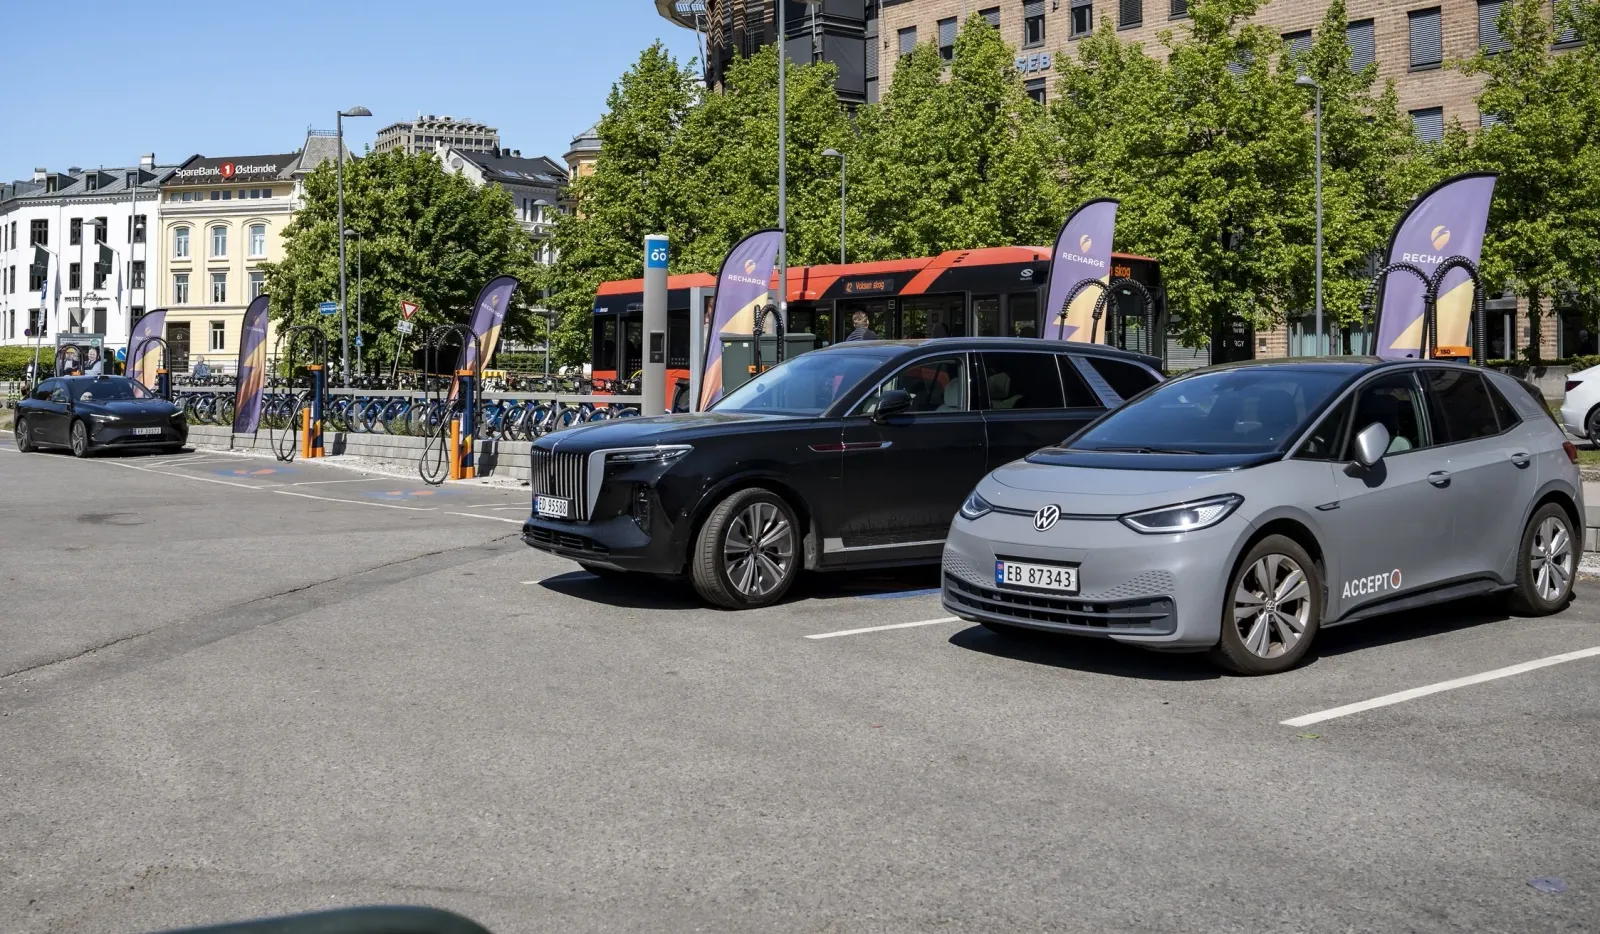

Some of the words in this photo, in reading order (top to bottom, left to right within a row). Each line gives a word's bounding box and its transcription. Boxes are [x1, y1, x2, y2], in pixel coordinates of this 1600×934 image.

[1015, 52, 1051, 72] SEB
[175, 167, 220, 178] SpareBank
[235, 164, 277, 174] Østlandet
[1062, 252, 1105, 268] RECHARGE
[728, 274, 767, 286] RECHARGE
[548, 499, 567, 515] 95588
[1007, 565, 1022, 582] EB
[1028, 567, 1071, 588] 87343
